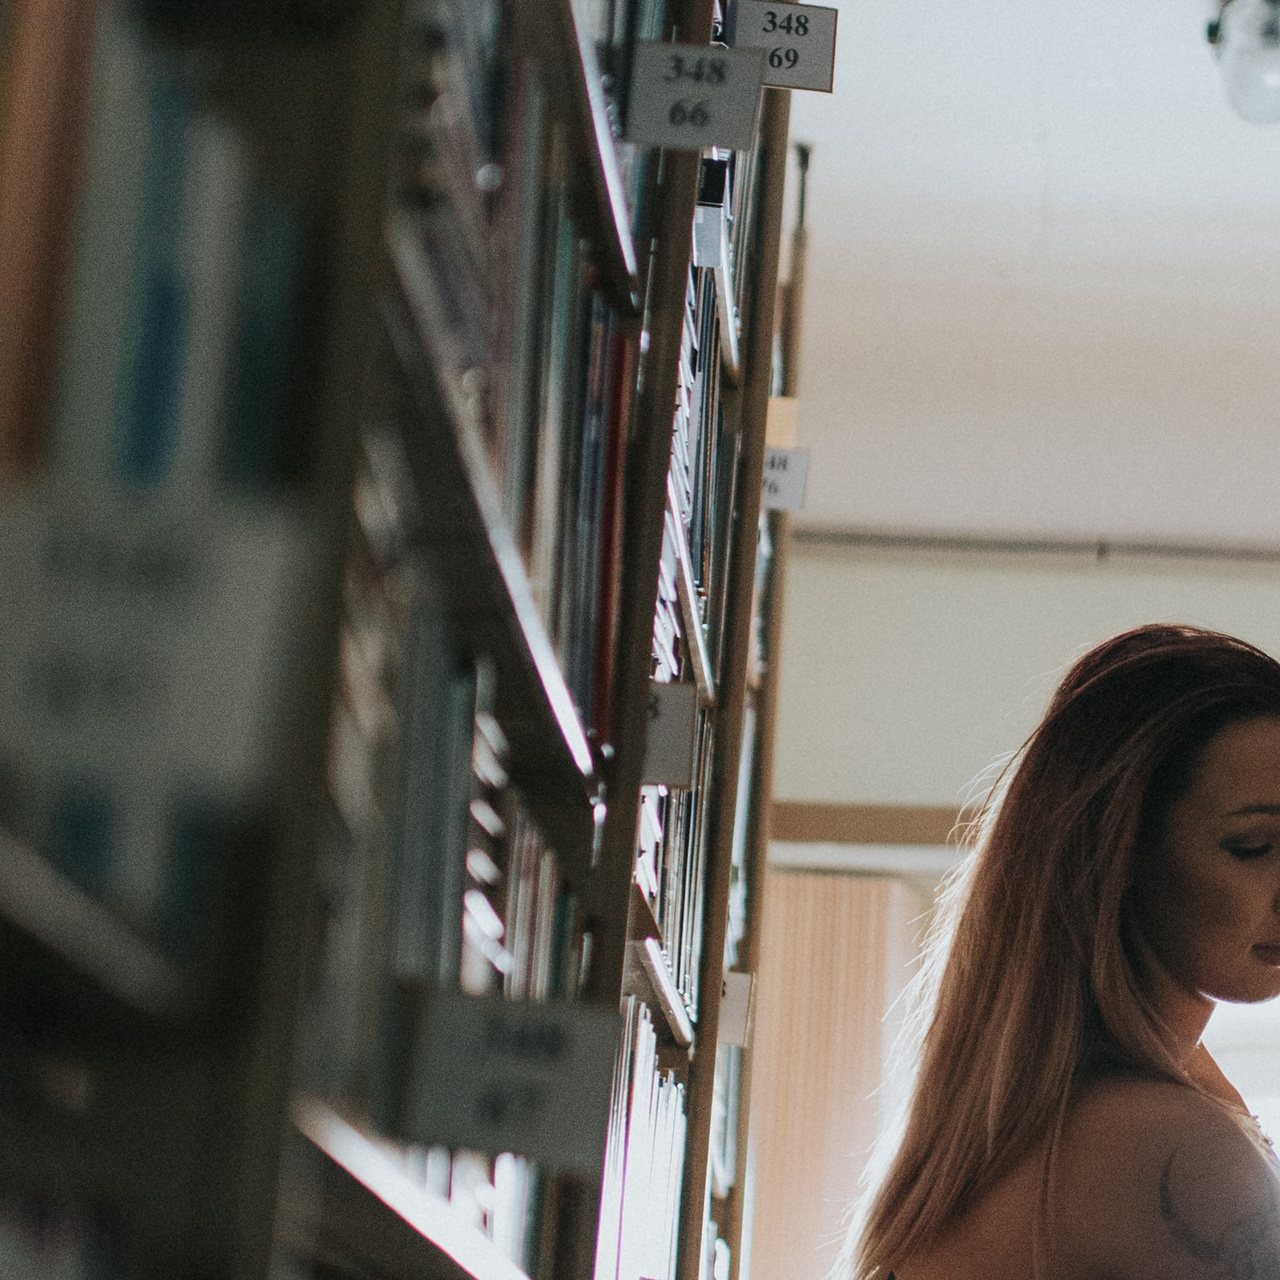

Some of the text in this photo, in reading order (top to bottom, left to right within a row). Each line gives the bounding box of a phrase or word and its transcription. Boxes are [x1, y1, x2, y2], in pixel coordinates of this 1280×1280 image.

[762, 11, 809, 36] 348
[663, 54, 728, 85] 348
[769, 48, 799, 69] 69
[669, 99, 709, 127] 66
[766, 455, 788, 471] 48
